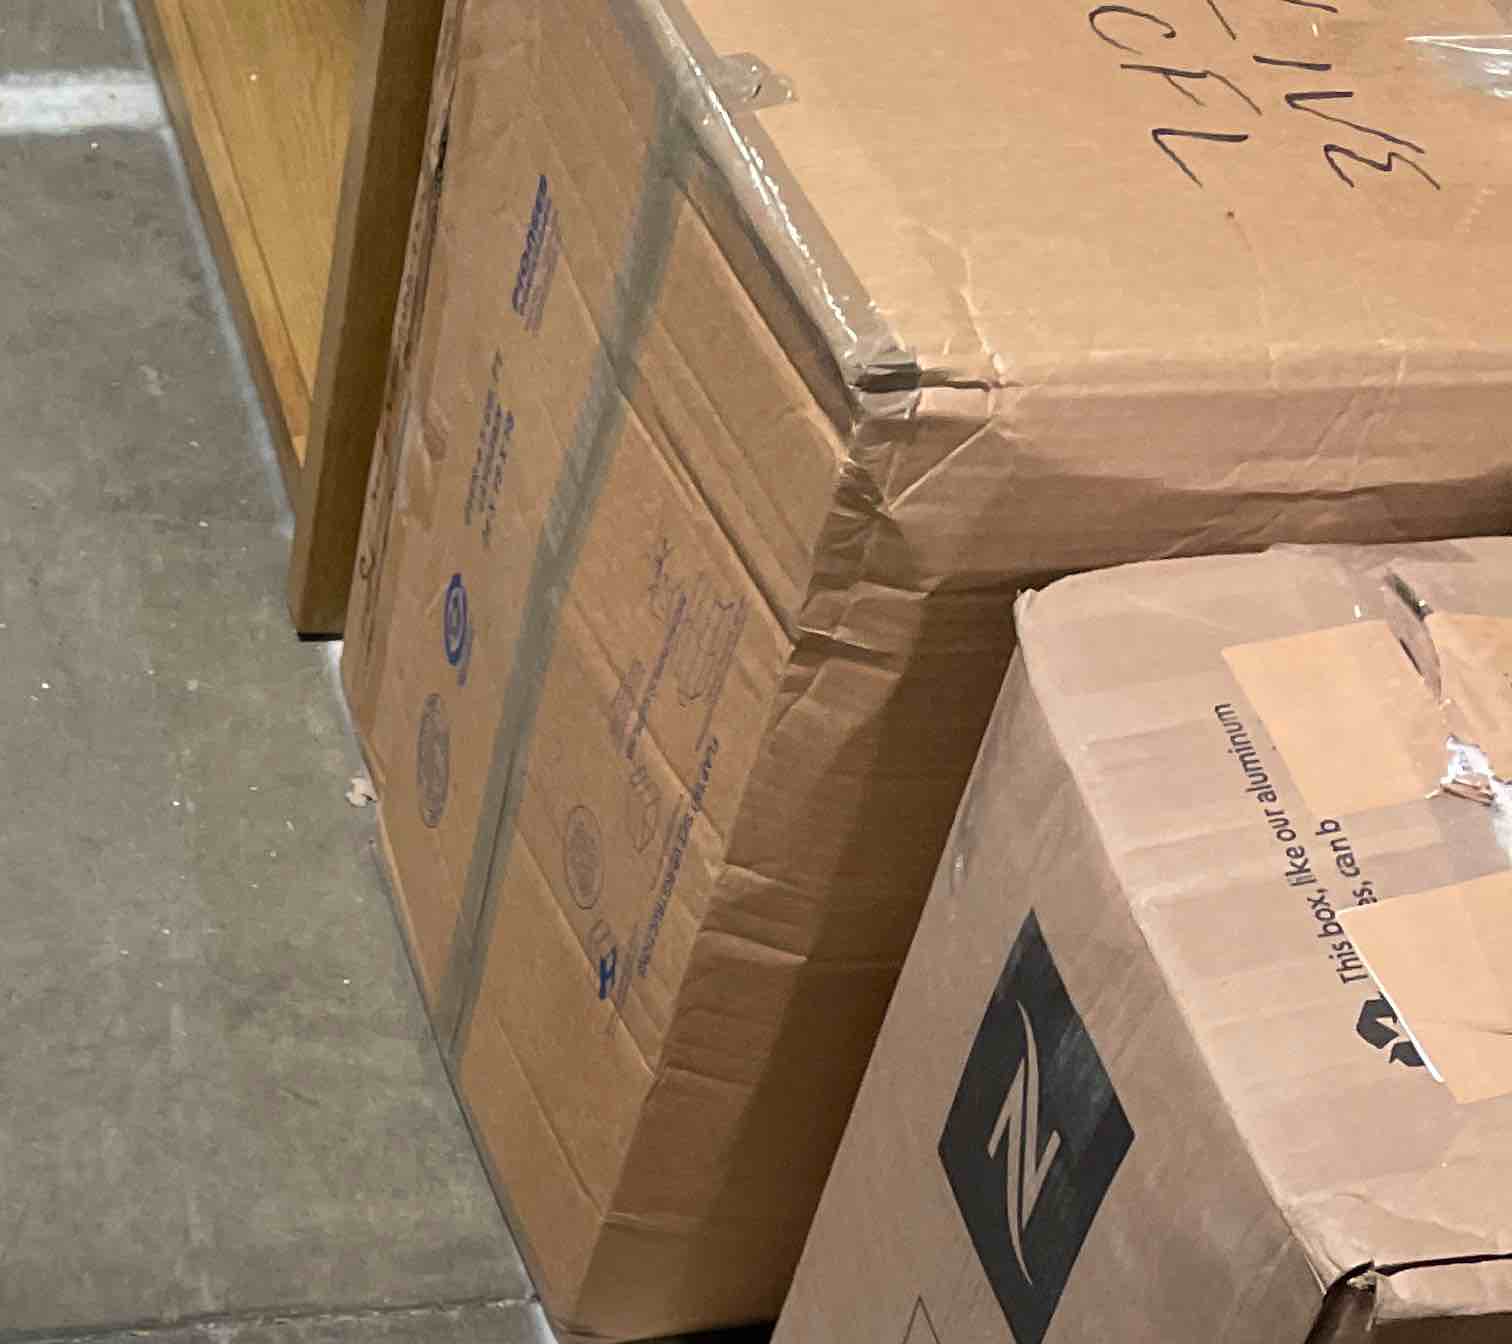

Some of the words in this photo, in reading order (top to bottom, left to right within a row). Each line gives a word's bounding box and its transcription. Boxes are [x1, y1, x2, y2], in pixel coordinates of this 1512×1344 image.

[1214, 702, 1279, 803] aluminum
[1263, 807, 1297, 843] our
[1284, 844, 1317, 887] like
[1329, 836, 1361, 878] can
[1306, 888, 1345, 938] box,
[1328, 938, 1369, 985] This
